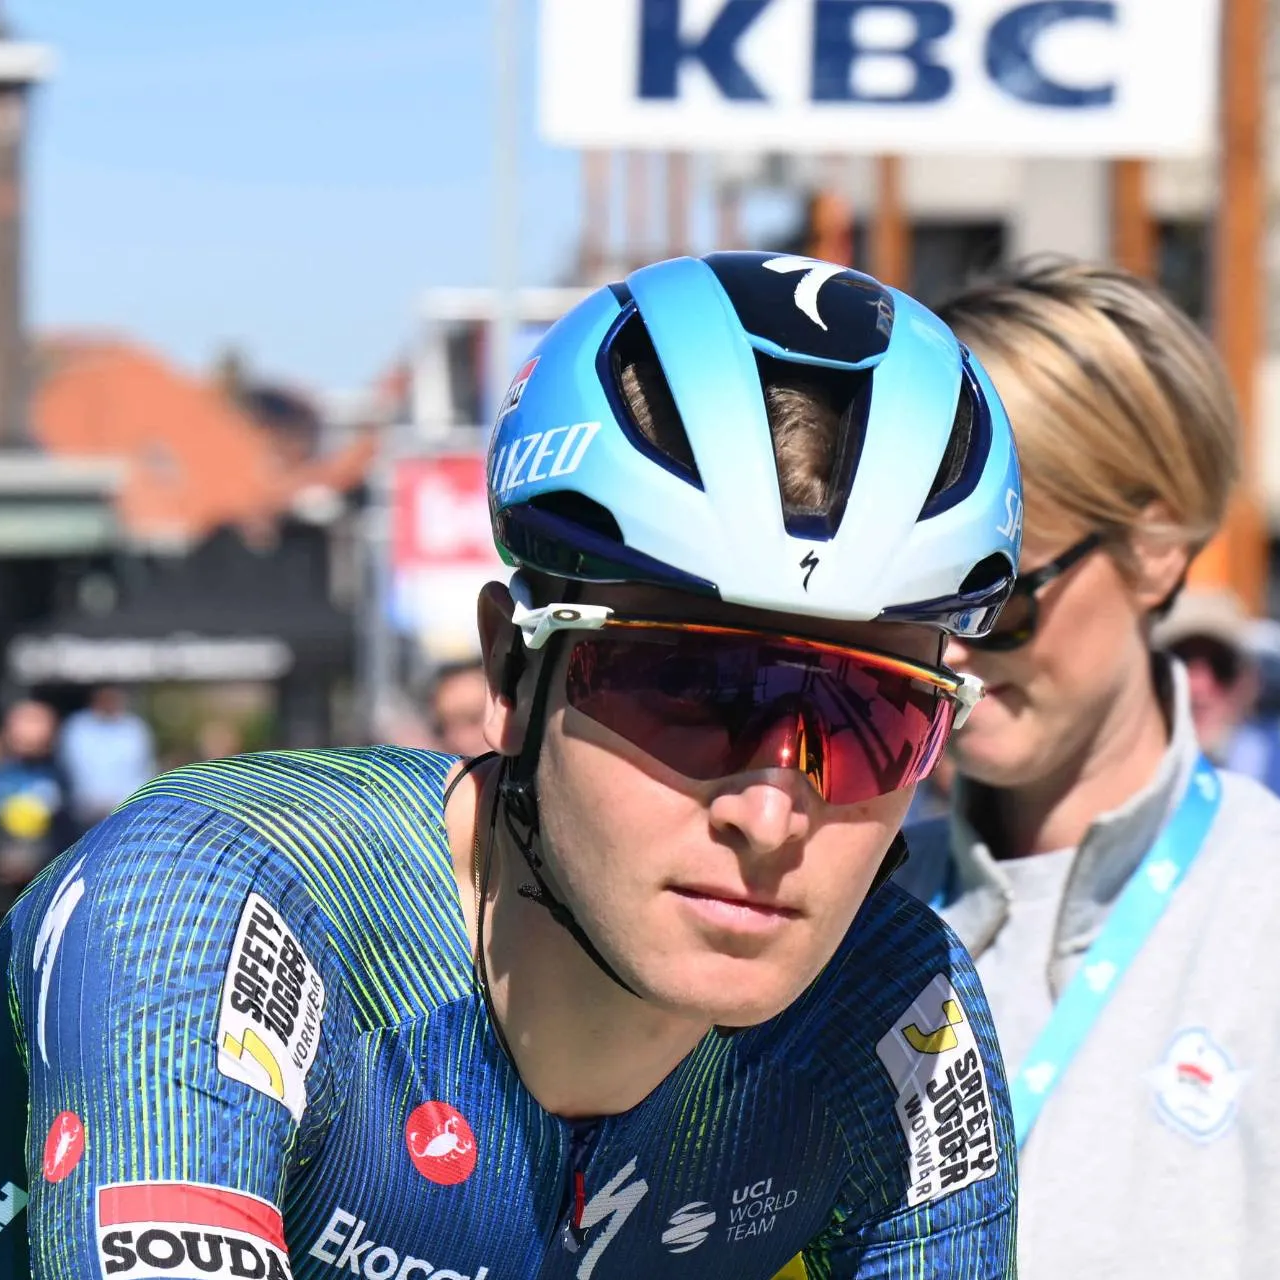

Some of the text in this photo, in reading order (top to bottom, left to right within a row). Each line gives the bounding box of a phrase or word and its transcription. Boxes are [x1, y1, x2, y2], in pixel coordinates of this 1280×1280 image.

[633, 0, 1118, 107] KBC
[231, 901, 282, 1025] SAFETY
[954, 1048, 998, 1172] SAFETY
[730, 1190, 798, 1223] WORLD
[732, 1177, 773, 1204] UCI
[726, 1215, 776, 1242] TEAM
